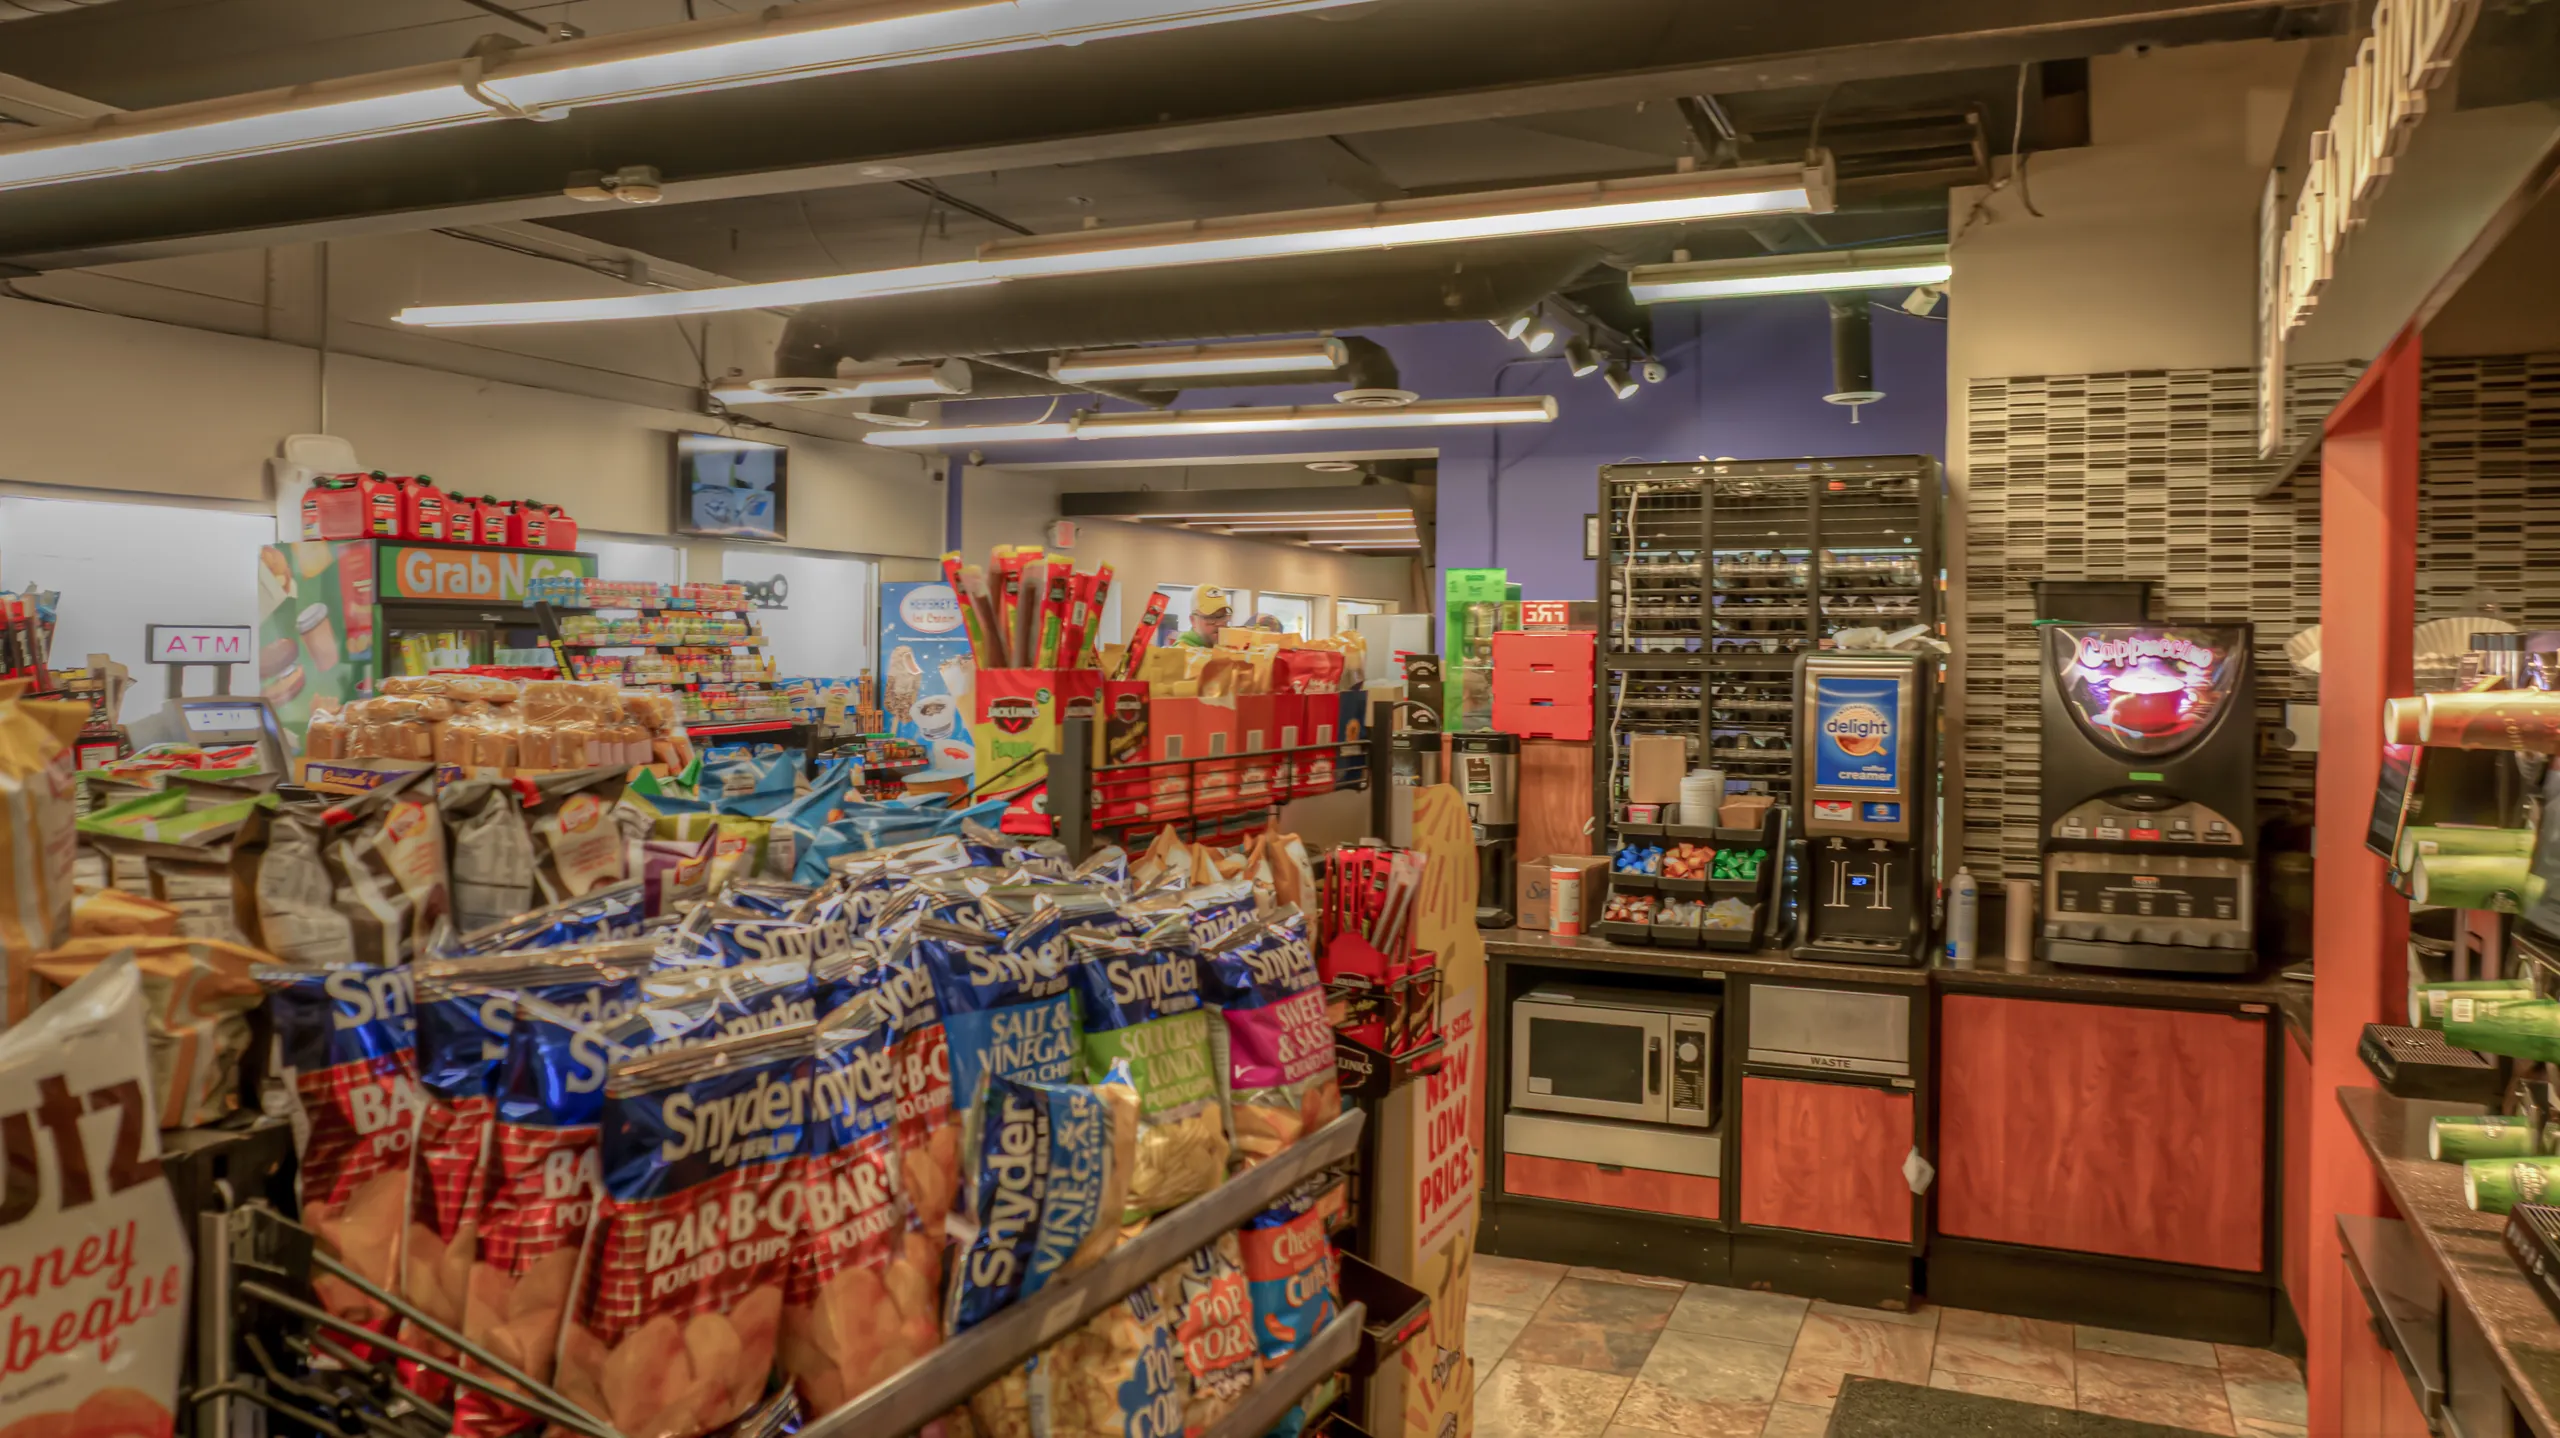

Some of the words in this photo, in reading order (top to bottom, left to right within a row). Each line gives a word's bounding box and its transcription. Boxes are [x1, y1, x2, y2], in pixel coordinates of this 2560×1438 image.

[405, 550, 493, 594] Grab
[498, 553, 525, 600] N
[165, 635, 239, 653] ATM
[2080, 636, 2213, 668] Cappuccino
[1826, 719, 1889, 738] delight
[1837, 770, 1893, 782] creamer
[991, 1006, 1050, 1039] SALT
[1425, 1042, 1469, 1113] NEW
[1809, 1056, 1852, 1069] WASTE
[661, 1072, 810, 1160] Snyder
[1427, 1094, 1467, 1162] LOW
[970, 1093, 1039, 1288] Snyder
[1035, 1094, 1090, 1274] VINEGAR
[651, 1248, 726, 1299] POTATO
[728, 1233, 791, 1270] CHIPS
[1196, 1284, 1243, 1327] POP
